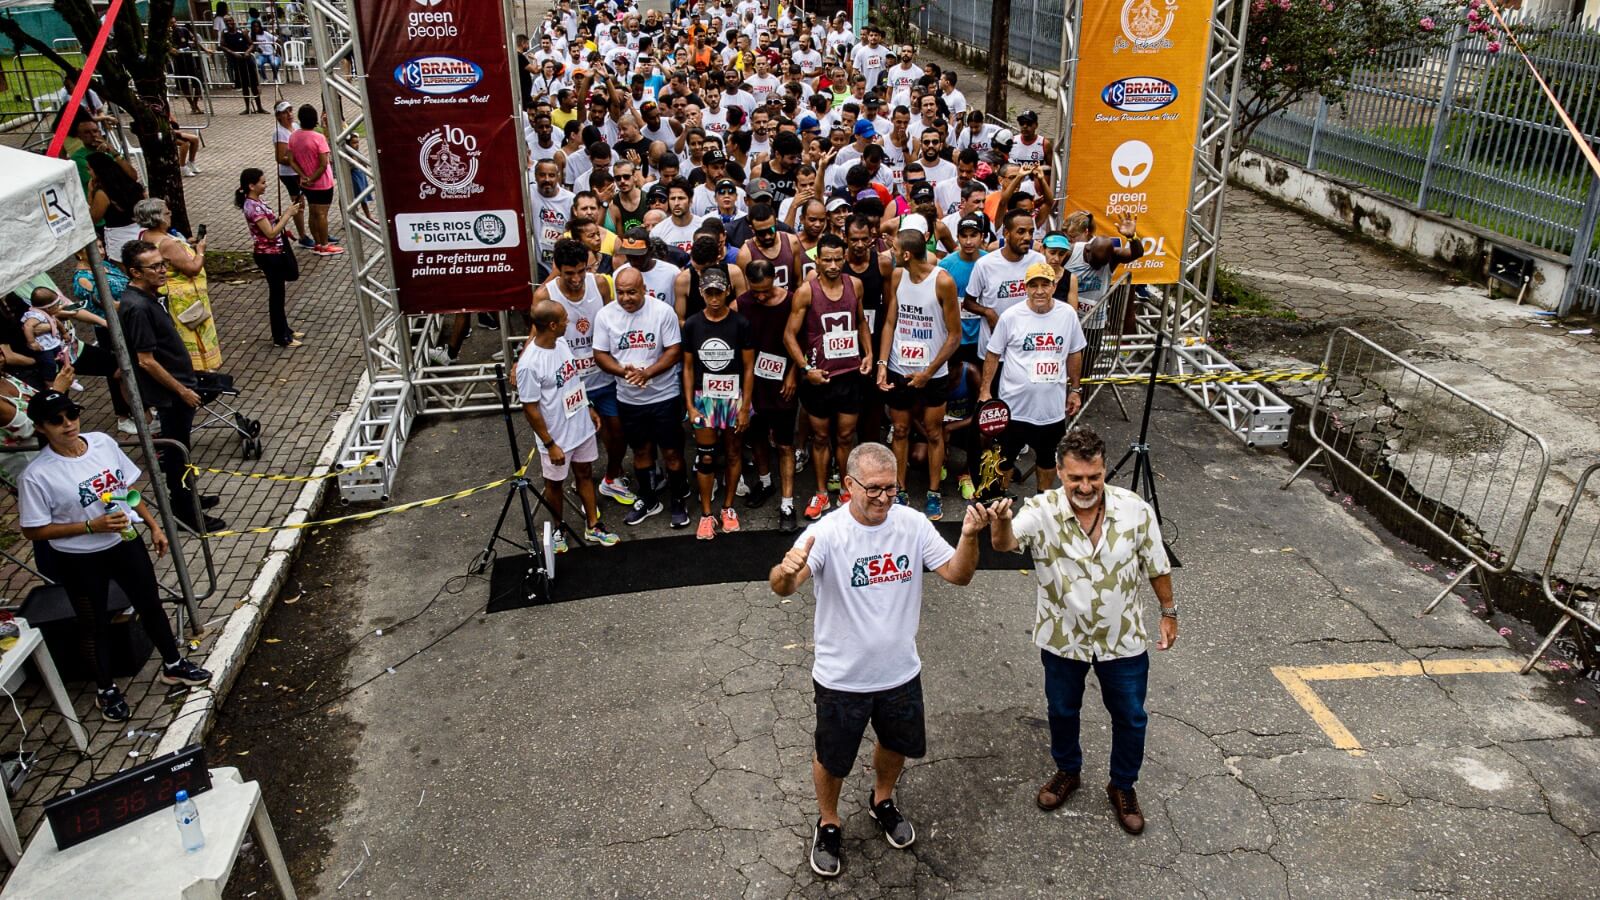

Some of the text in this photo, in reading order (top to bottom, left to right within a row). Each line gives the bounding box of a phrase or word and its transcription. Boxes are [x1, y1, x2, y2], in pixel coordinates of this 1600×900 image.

[408, 11, 452, 25] green
[407, 23, 458, 39] people
[421, 62, 475, 74] BRAMIL
[1125, 83, 1172, 93] BRAMIL
[394, 96, 421, 107] Sempre
[422, 95, 456, 104] Pensando
[1095, 113, 1119, 123] Sempre
[1120, 113, 1150, 121] Pensando
[443, 124, 477, 151] 100
[1109, 191, 1146, 205] green
[1106, 202, 1148, 216] people
[409, 220, 471, 232] TRÊS RIOS
[546, 230, 562, 240] 02
[417, 253, 507, 266] É a Prefeitura na
[1144, 259, 1164, 268] Rios
[412, 263, 514, 278] palma da sua mão.
[900, 304, 923, 315] SEM
[899, 312, 934, 322] TROCINADOR
[912, 328, 933, 339] AQUI
[830, 338, 853, 350] 087
[901, 346, 924, 359] 272
[759, 358, 783, 373] 003
[1037, 363, 1058, 374] 002
[709, 380, 733, 391] 245
[566, 389, 583, 409] 221
[856, 554, 882, 564] CORRIDA
[870, 569, 912, 585] SEBASTIÃO
